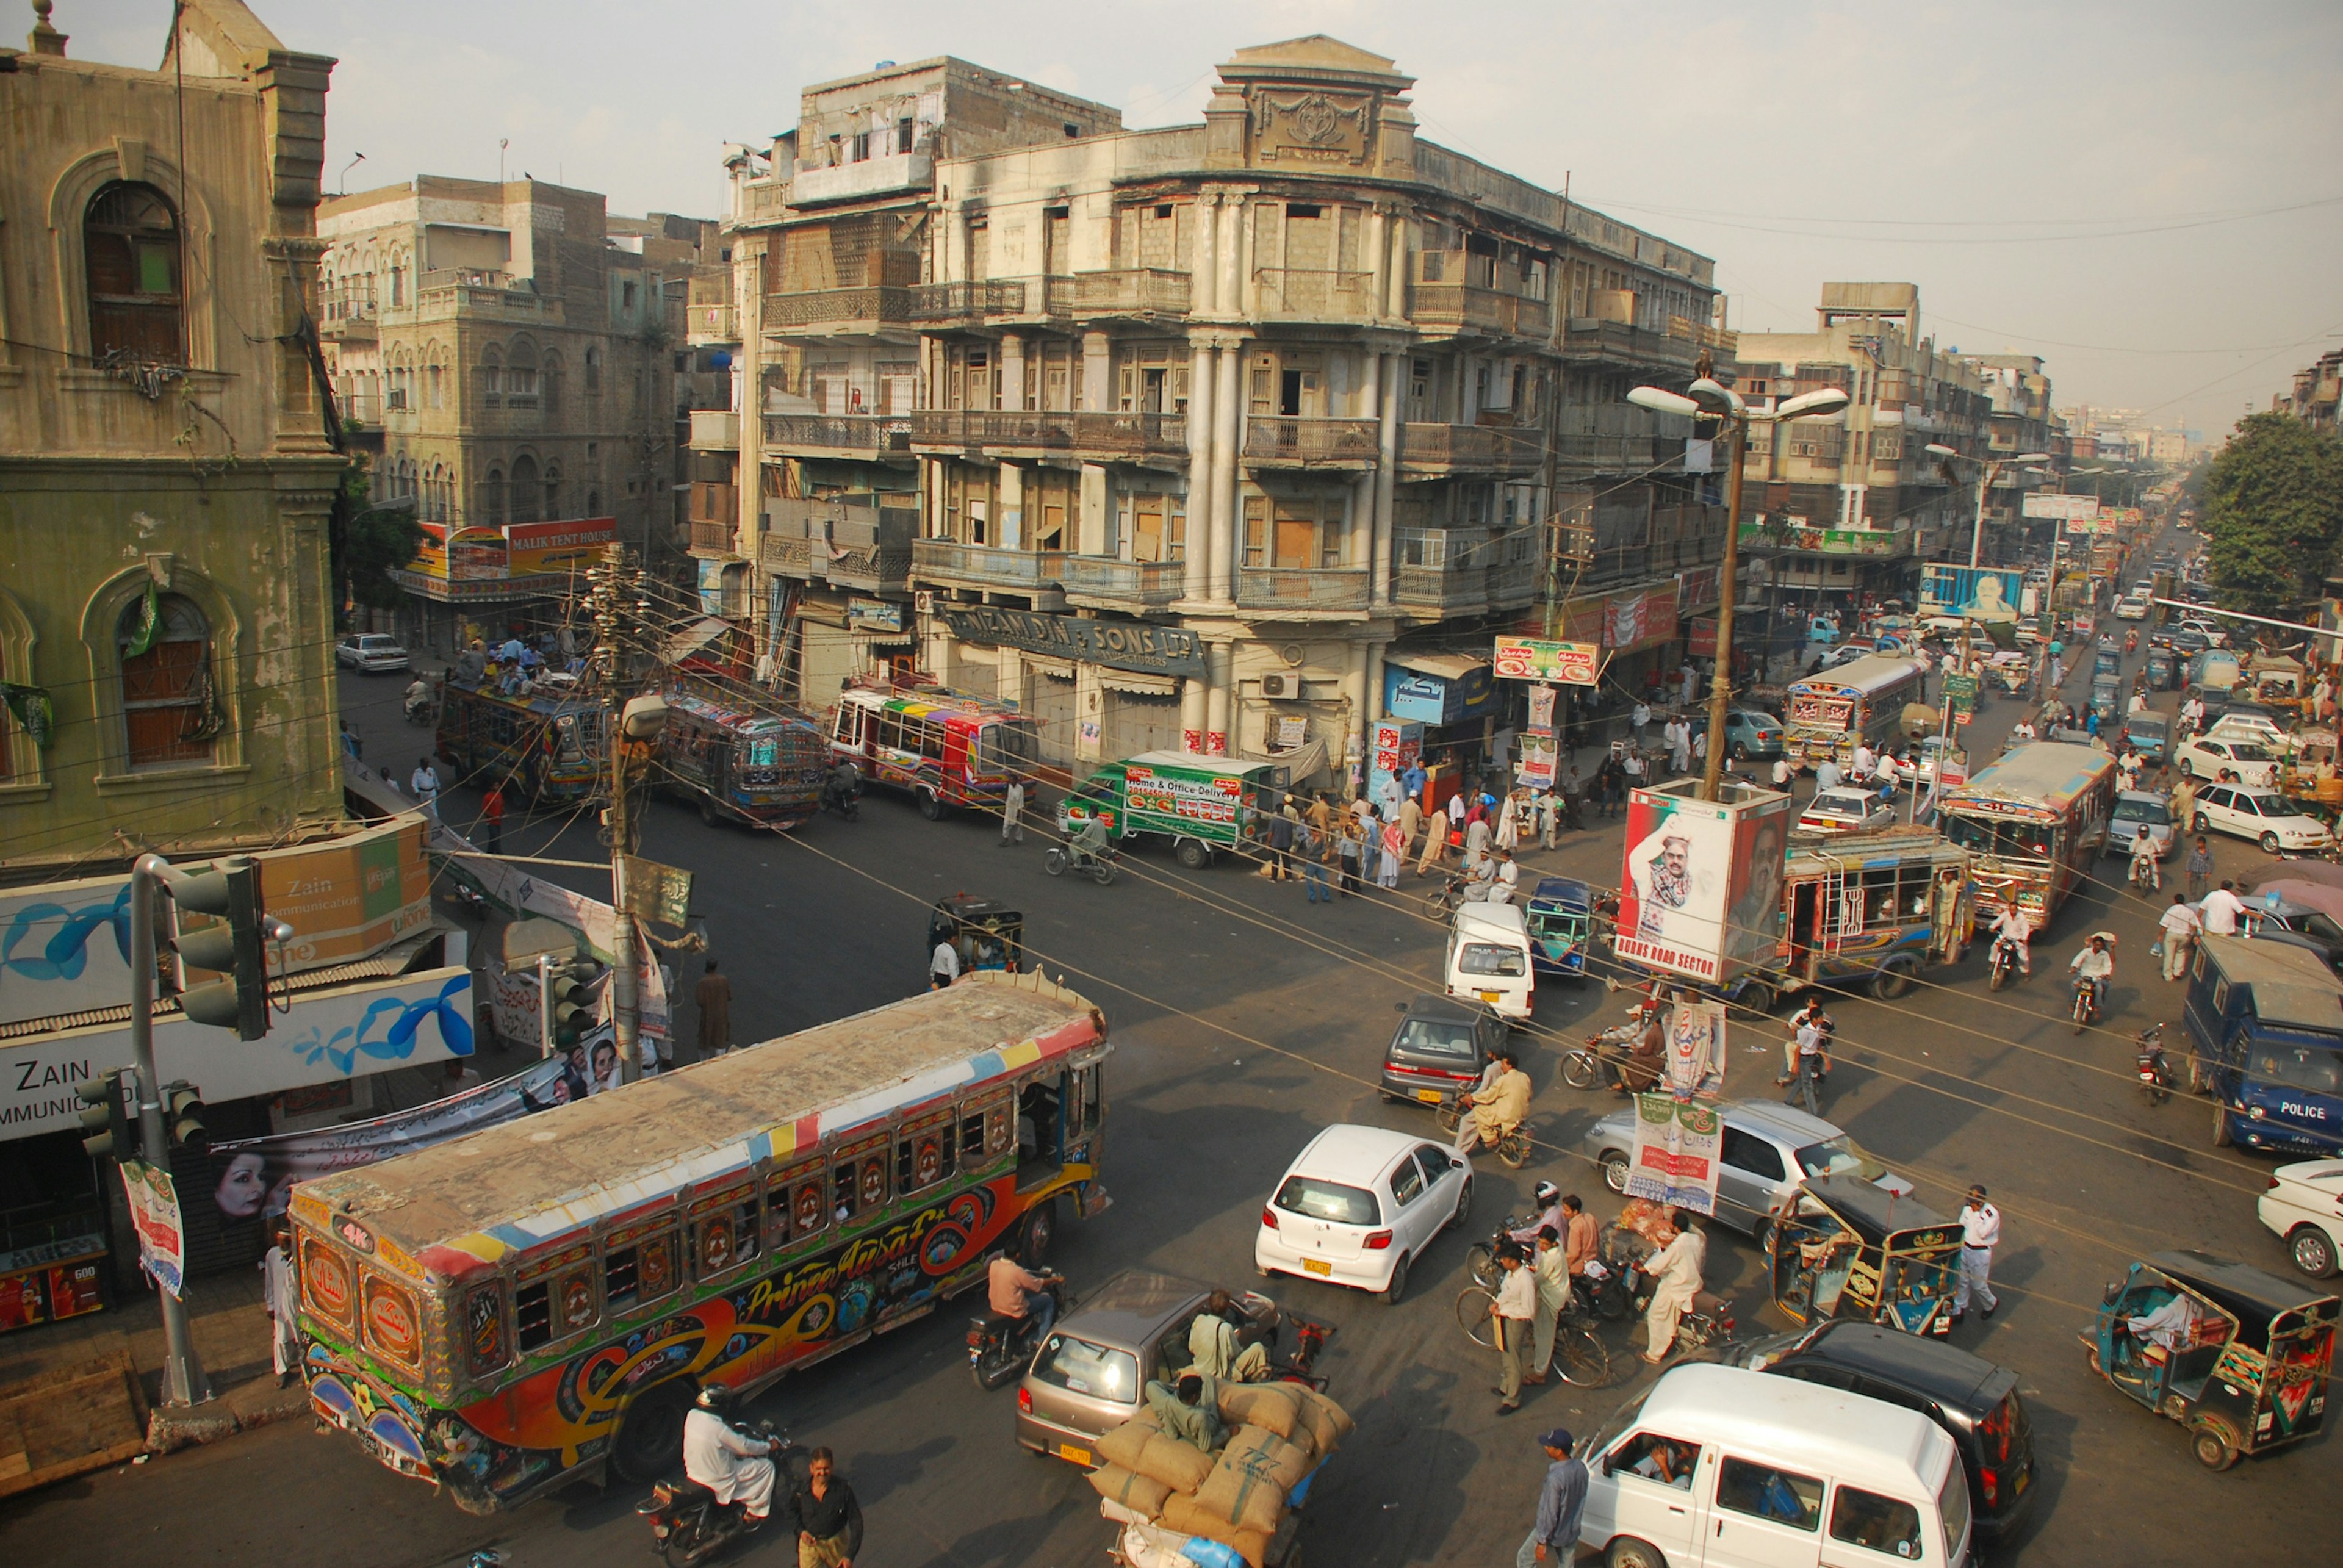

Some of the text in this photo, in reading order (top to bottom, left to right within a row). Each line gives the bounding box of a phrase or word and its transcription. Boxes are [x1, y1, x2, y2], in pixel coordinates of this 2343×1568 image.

[513, 529, 613, 550] MALIK TENT HOUSE
[1030, 617, 1072, 645] DIN
[1093, 625, 1156, 655] SONS
[1093, 650, 1167, 668] MANUFACTURERS
[1168, 782, 1198, 794] Office
[1198, 786, 1236, 801] Delivery
[1650, 798, 1670, 808] MQM
[287, 877, 332, 898] Zain
[265, 896, 360, 917] ommunication
[1618, 938, 1714, 976] BURNS ROAD SECTOR
[2281, 1101, 2325, 1120] POLICE
[343, 1222, 367, 1250] 4K
